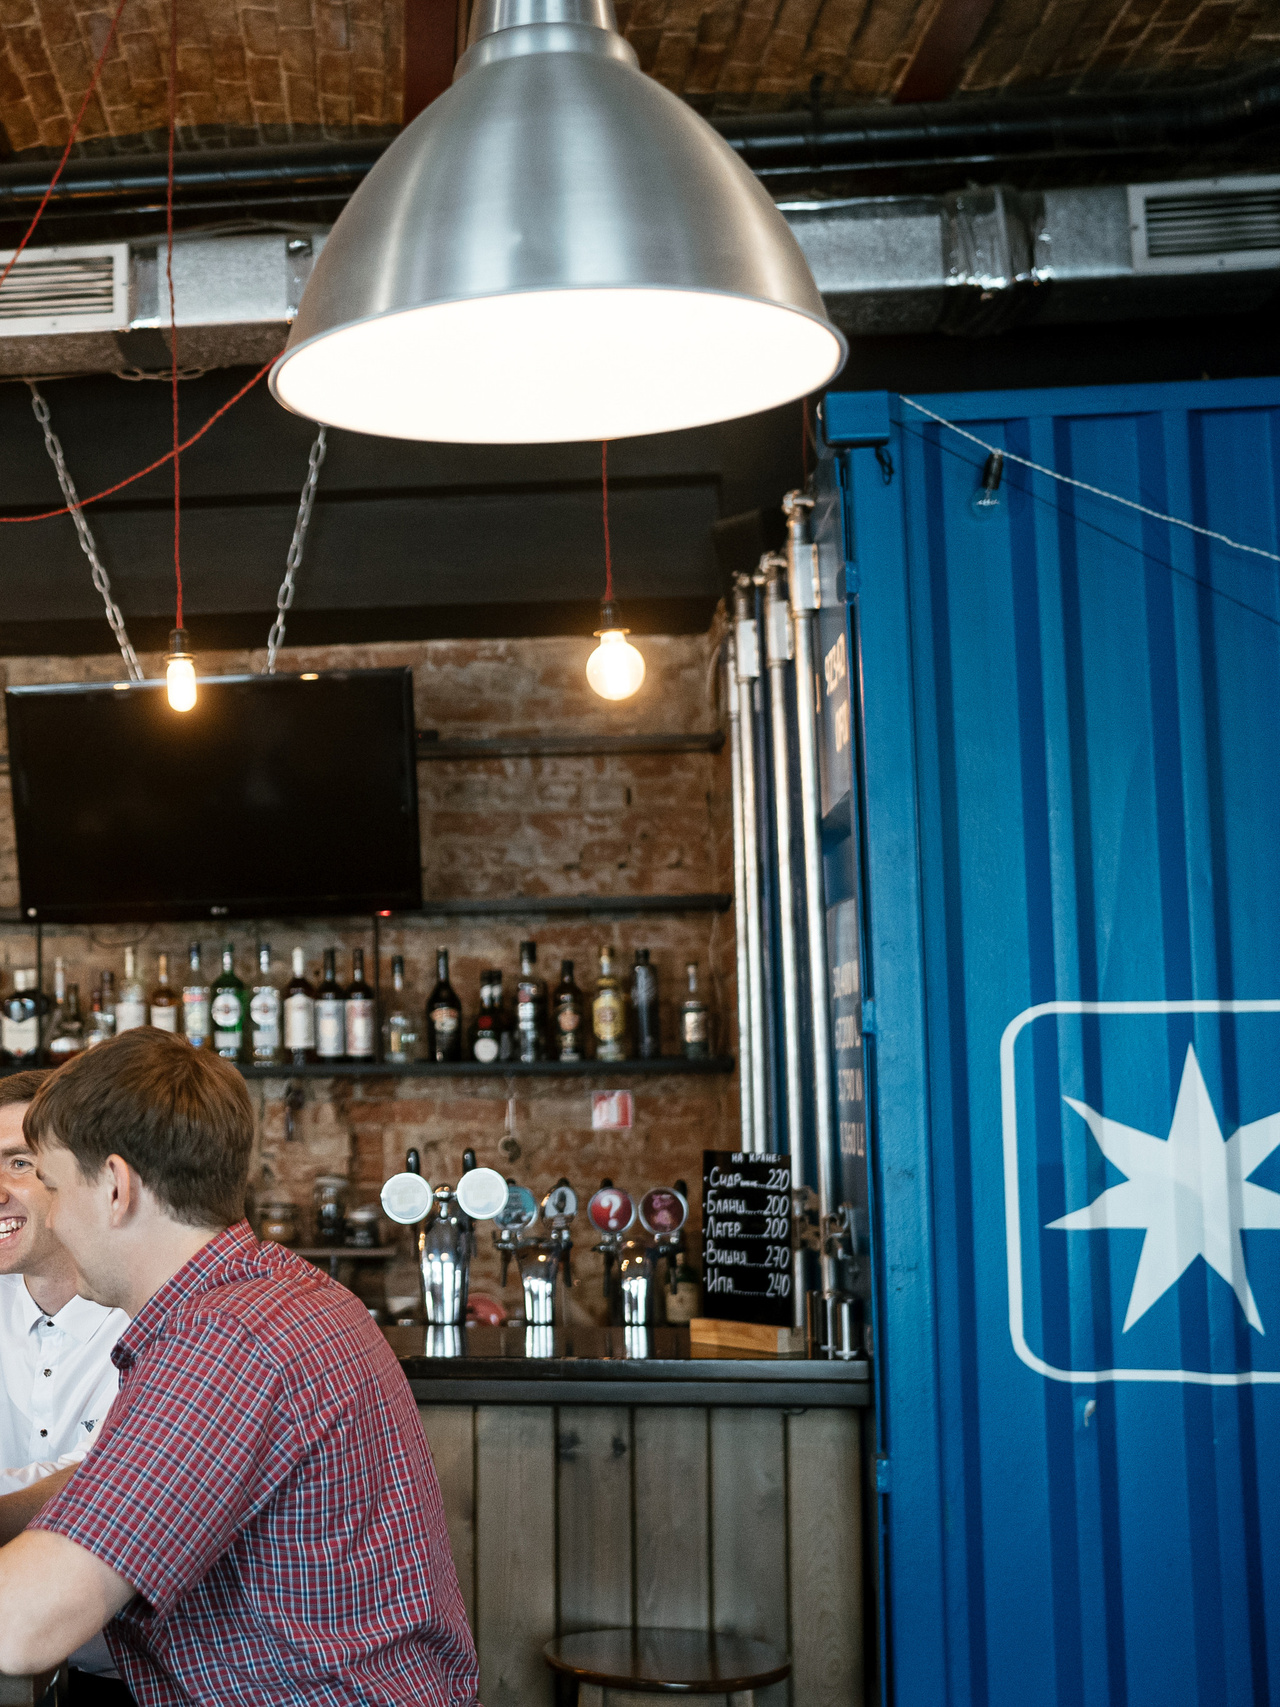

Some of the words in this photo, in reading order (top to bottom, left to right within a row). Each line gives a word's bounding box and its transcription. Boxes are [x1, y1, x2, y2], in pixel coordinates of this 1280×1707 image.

[731, 1153, 744, 1163] НА
[766, 1168, 791, 1192] 220
[764, 1195, 790, 1217] 200
[763, 1217, 789, 1240] 200
[764, 1245, 790, 1269] 270
[766, 1272, 791, 1298] 240
